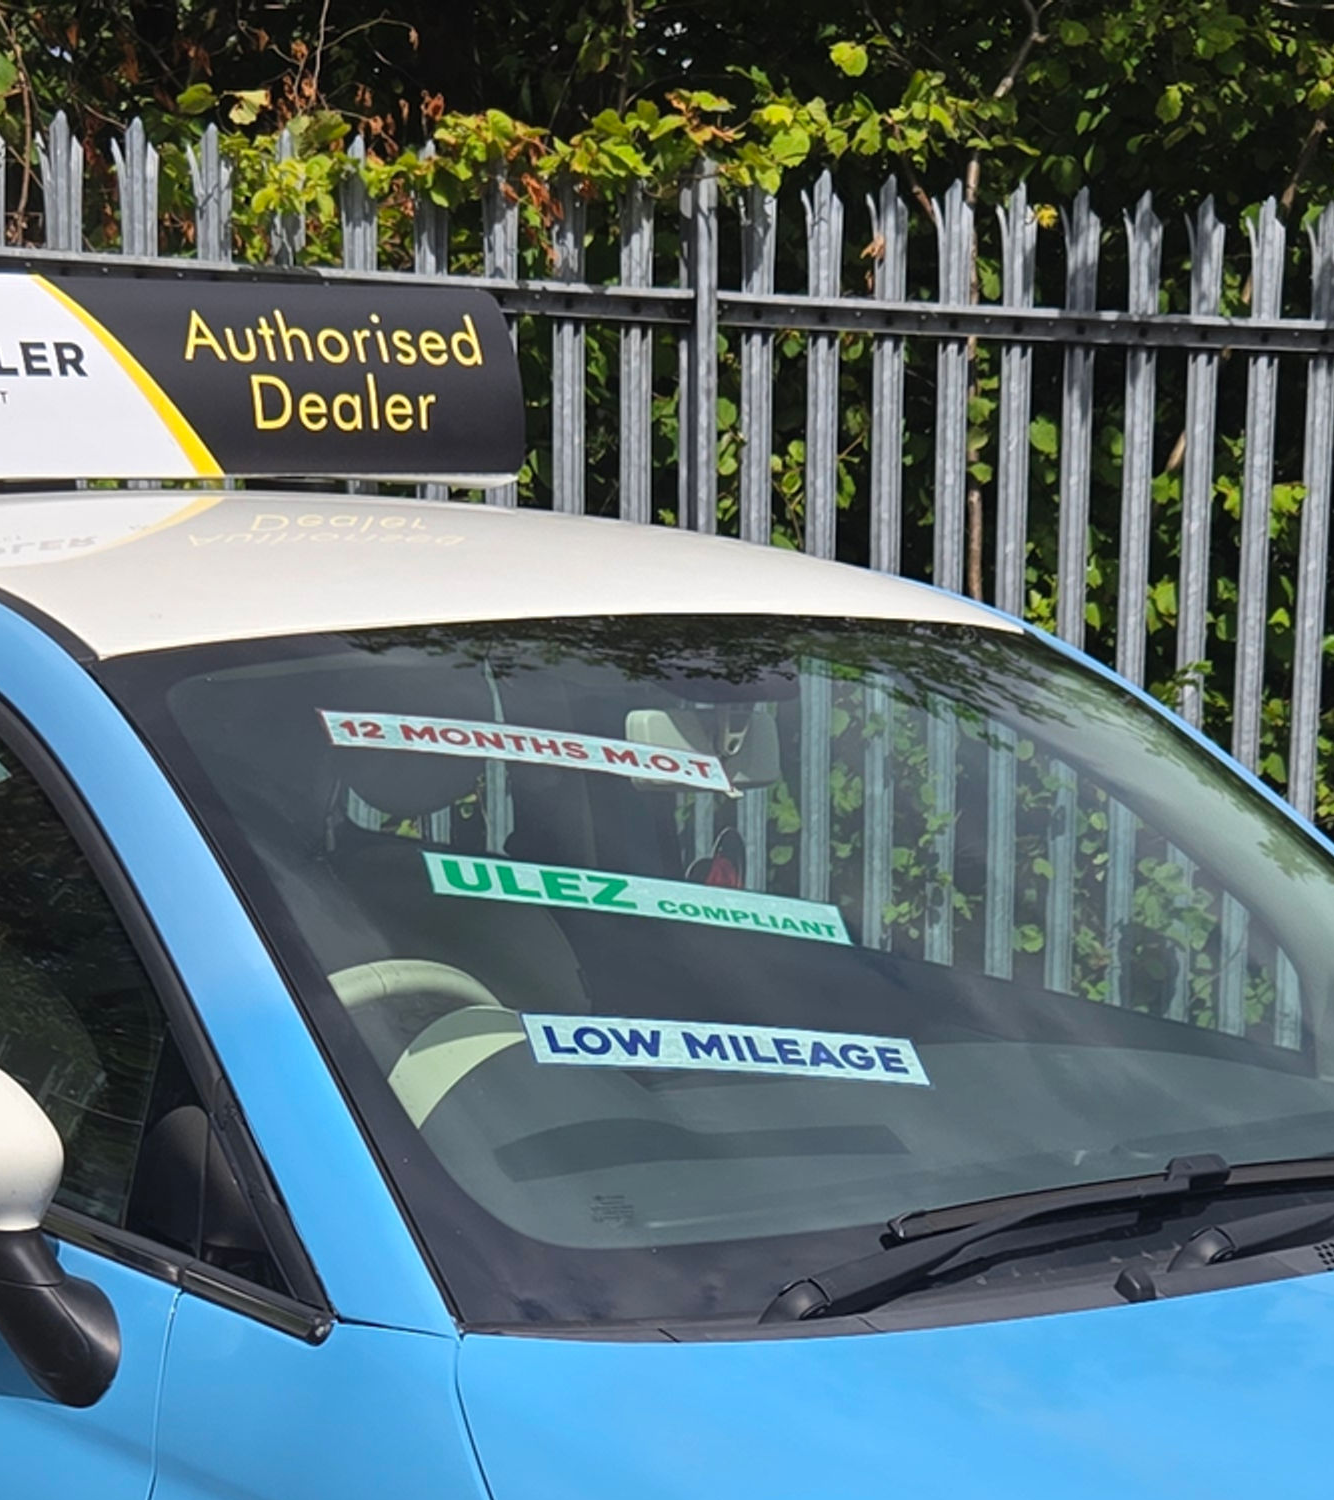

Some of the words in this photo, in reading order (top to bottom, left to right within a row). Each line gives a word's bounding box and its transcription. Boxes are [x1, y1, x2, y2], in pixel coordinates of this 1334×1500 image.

[184, 309, 484, 367] Authorised
[250, 373, 437, 432] Dealer
[339, 720, 387, 741] 12
[399, 722, 591, 760] MONTHS
[601, 745, 713, 779] M.O.T
[442, 859, 638, 910] ULEZ
[657, 899, 838, 938] COMPLIANT
[543, 1025, 662, 1057] LOW
[681, 1030, 910, 1075] MILEAGE
